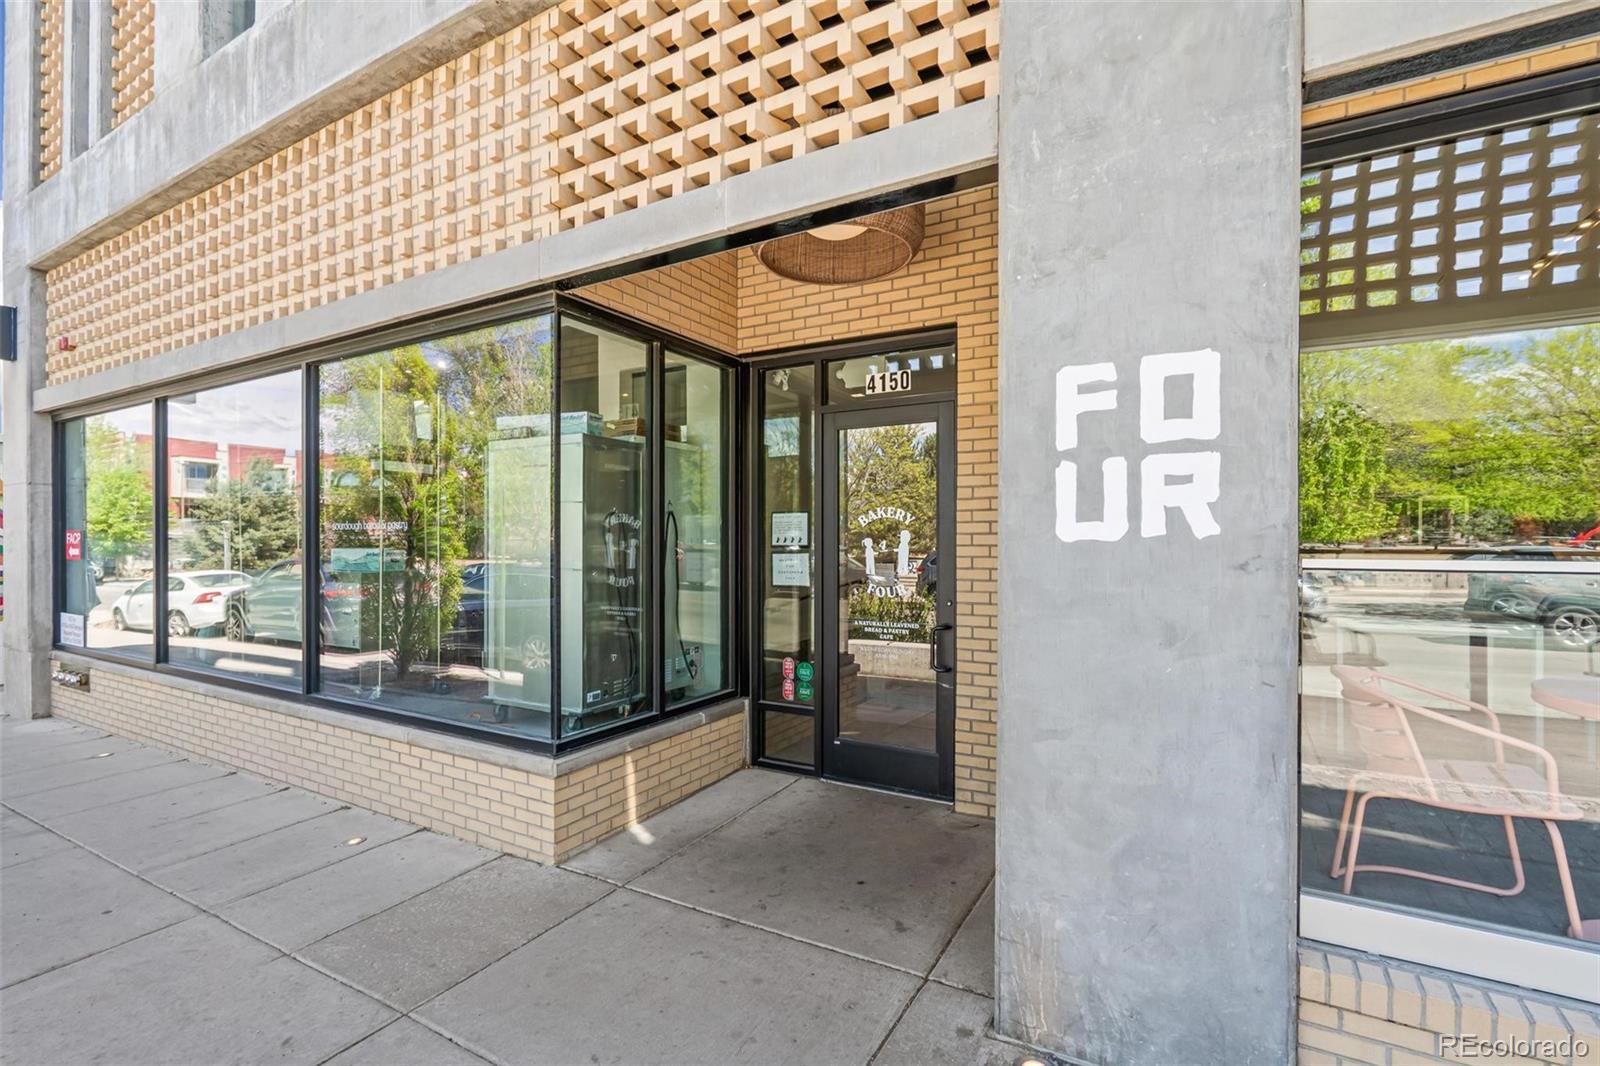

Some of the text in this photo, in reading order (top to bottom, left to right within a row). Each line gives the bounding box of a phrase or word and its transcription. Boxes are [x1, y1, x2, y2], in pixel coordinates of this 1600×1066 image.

[868, 371, 909, 393] 4150
[858, 506, 915, 527] BAKERY
[333, 520, 362, 532] sourdough
[387, 520, 408, 532] pastry
[66, 532, 81, 544] FACP
[867, 583, 907, 598] FOUR
